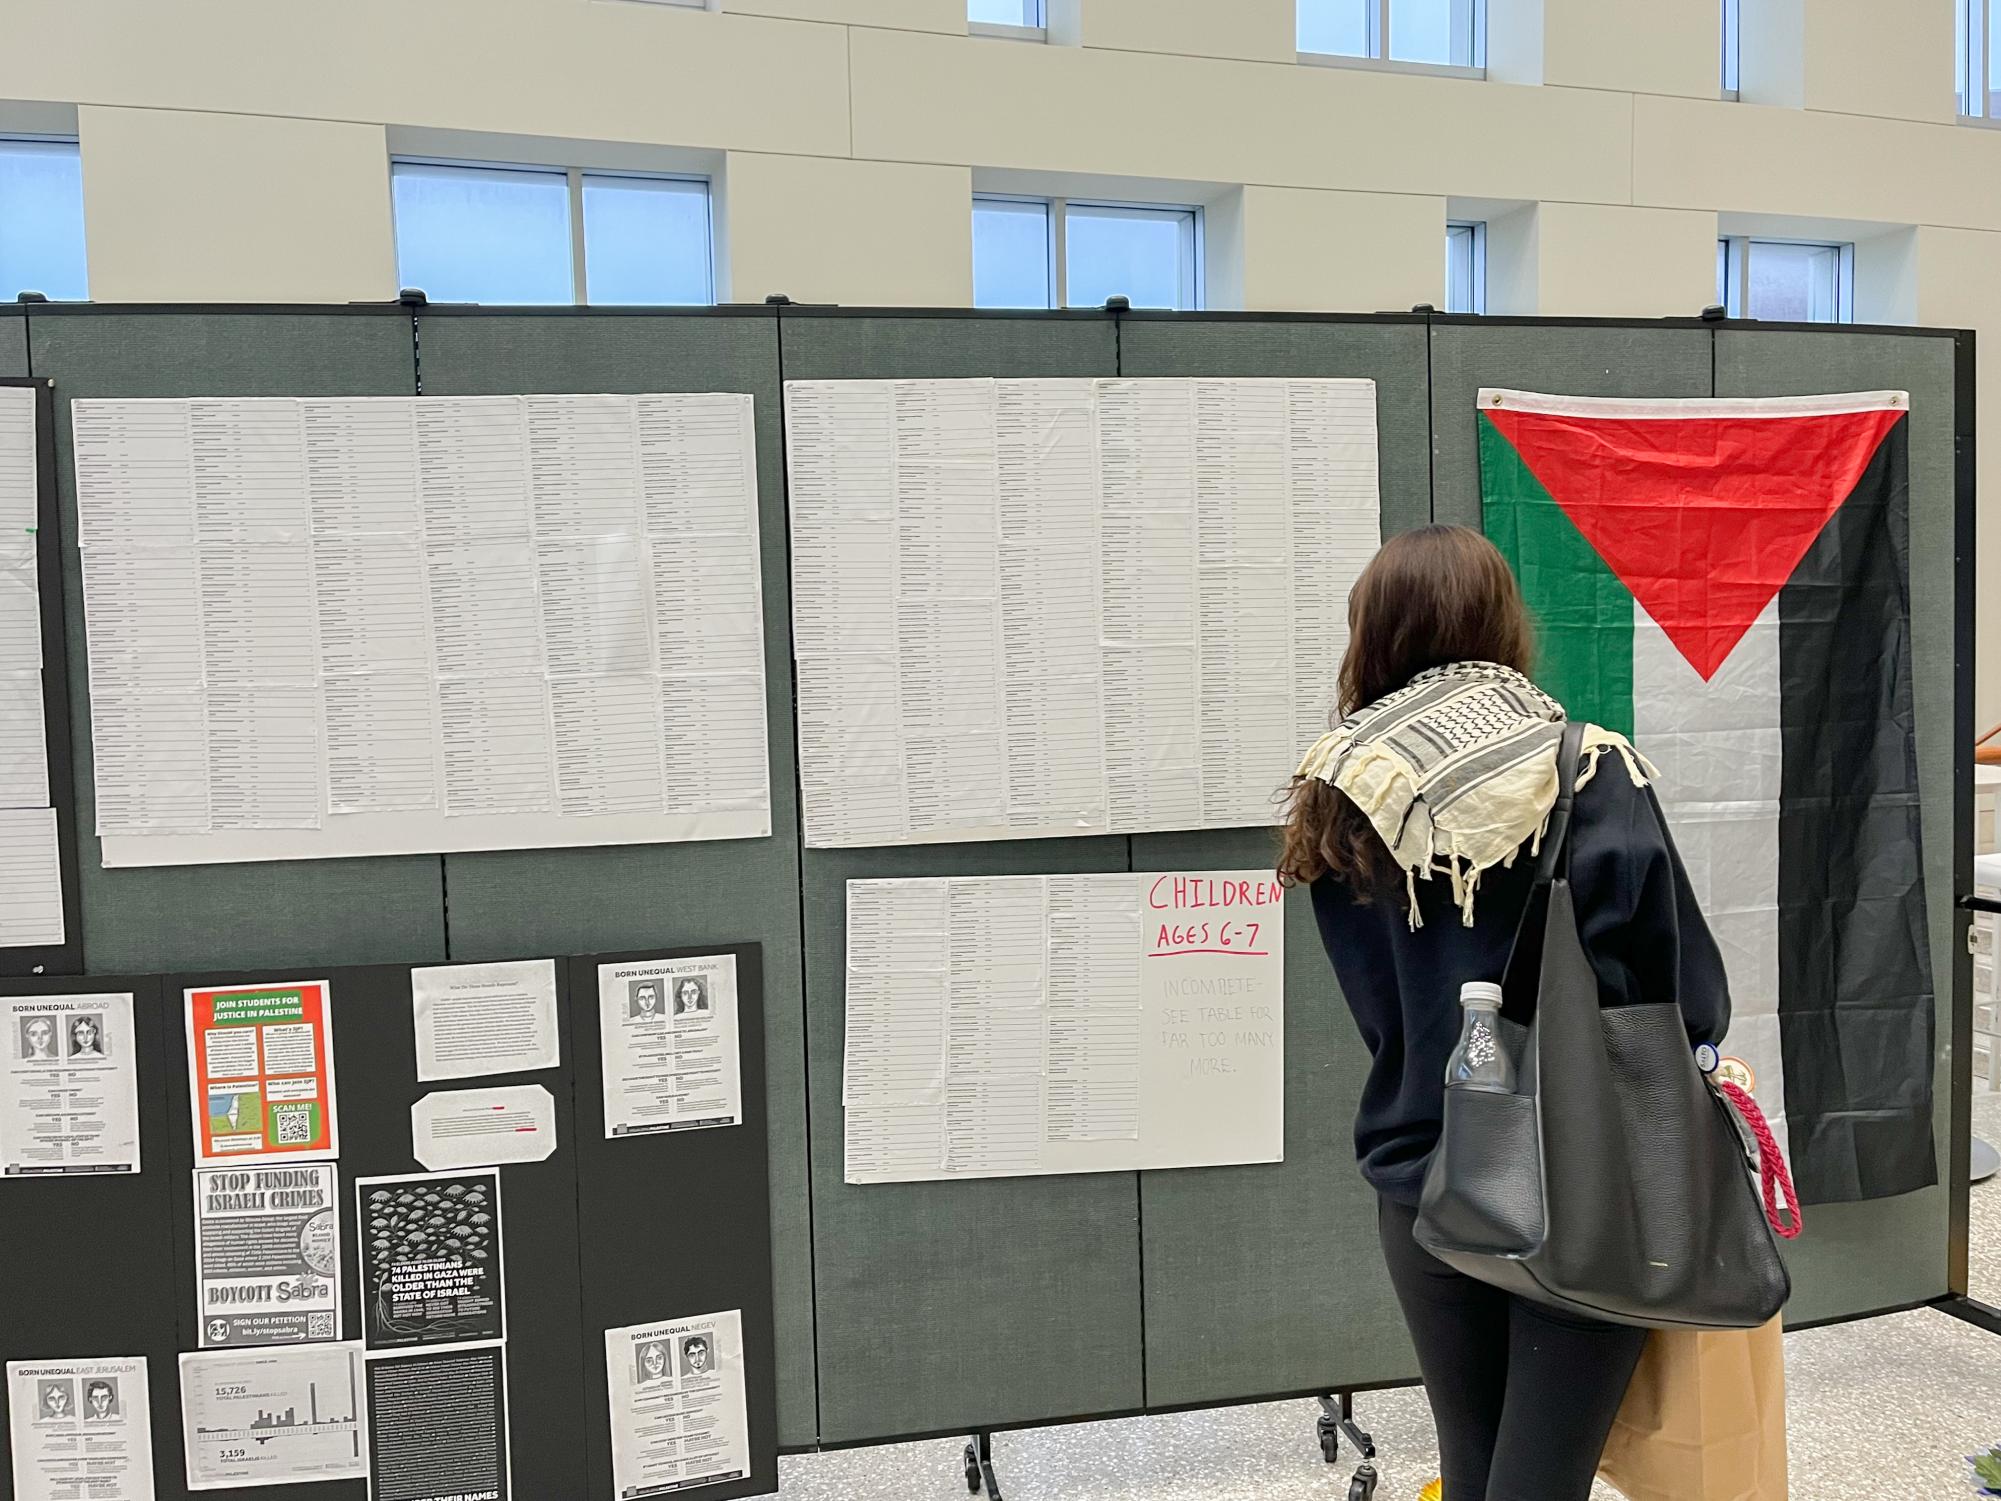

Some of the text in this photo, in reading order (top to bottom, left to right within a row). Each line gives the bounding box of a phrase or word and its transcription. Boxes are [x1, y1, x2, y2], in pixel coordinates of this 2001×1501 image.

[1150, 876, 1281, 908] CHILDREN
[1157, 921, 1259, 948] AGES 6-7
[615, 964, 718, 978] BORN UNEQUAL WEST BANK
[36, 1003, 75, 1011] UNEQUAL
[76, 1002, 109, 1010] ABROAD
[216, 1000, 236, 1010] JOIN
[238, 998, 281, 1008] STUDENTS
[213, 1011, 245, 1021] JUSTICE
[259, 1007, 303, 1017] PALESTINE
[1162, 1006, 1273, 1025] SEE TABLE FOR
[1200, 1032, 1226, 1048] TOO
[1235, 1031, 1274, 1048] MANY
[272, 1103, 312, 1113] SCAN ME!
[209, 1169, 319, 1192] STOP FUNDING
[207, 1189, 324, 1212] ISRAELI CRIMES
[309, 1222, 333, 1232] Sabra
[402, 1261, 463, 1273] PALESTINIANS
[392, 1267, 484, 1283] KILLED IN GAZA WERE
[392, 1277, 474, 1292] OLDER THAN THE
[207, 1281, 329, 1305] BOYCOTT Sabra
[392, 1287, 470, 1302] STATE OF ISRAEL
[631, 1321, 717, 1340] BORN UNEQUAL NEGEV
[40, 1368, 76, 1376] UNEQUAL
[95, 1365, 136, 1373] JERUSALEM
[215, 1386, 246, 1396] 15,726
[219, 1449, 245, 1458] 3,159
[464, 1491, 498, 1501] NAMES
